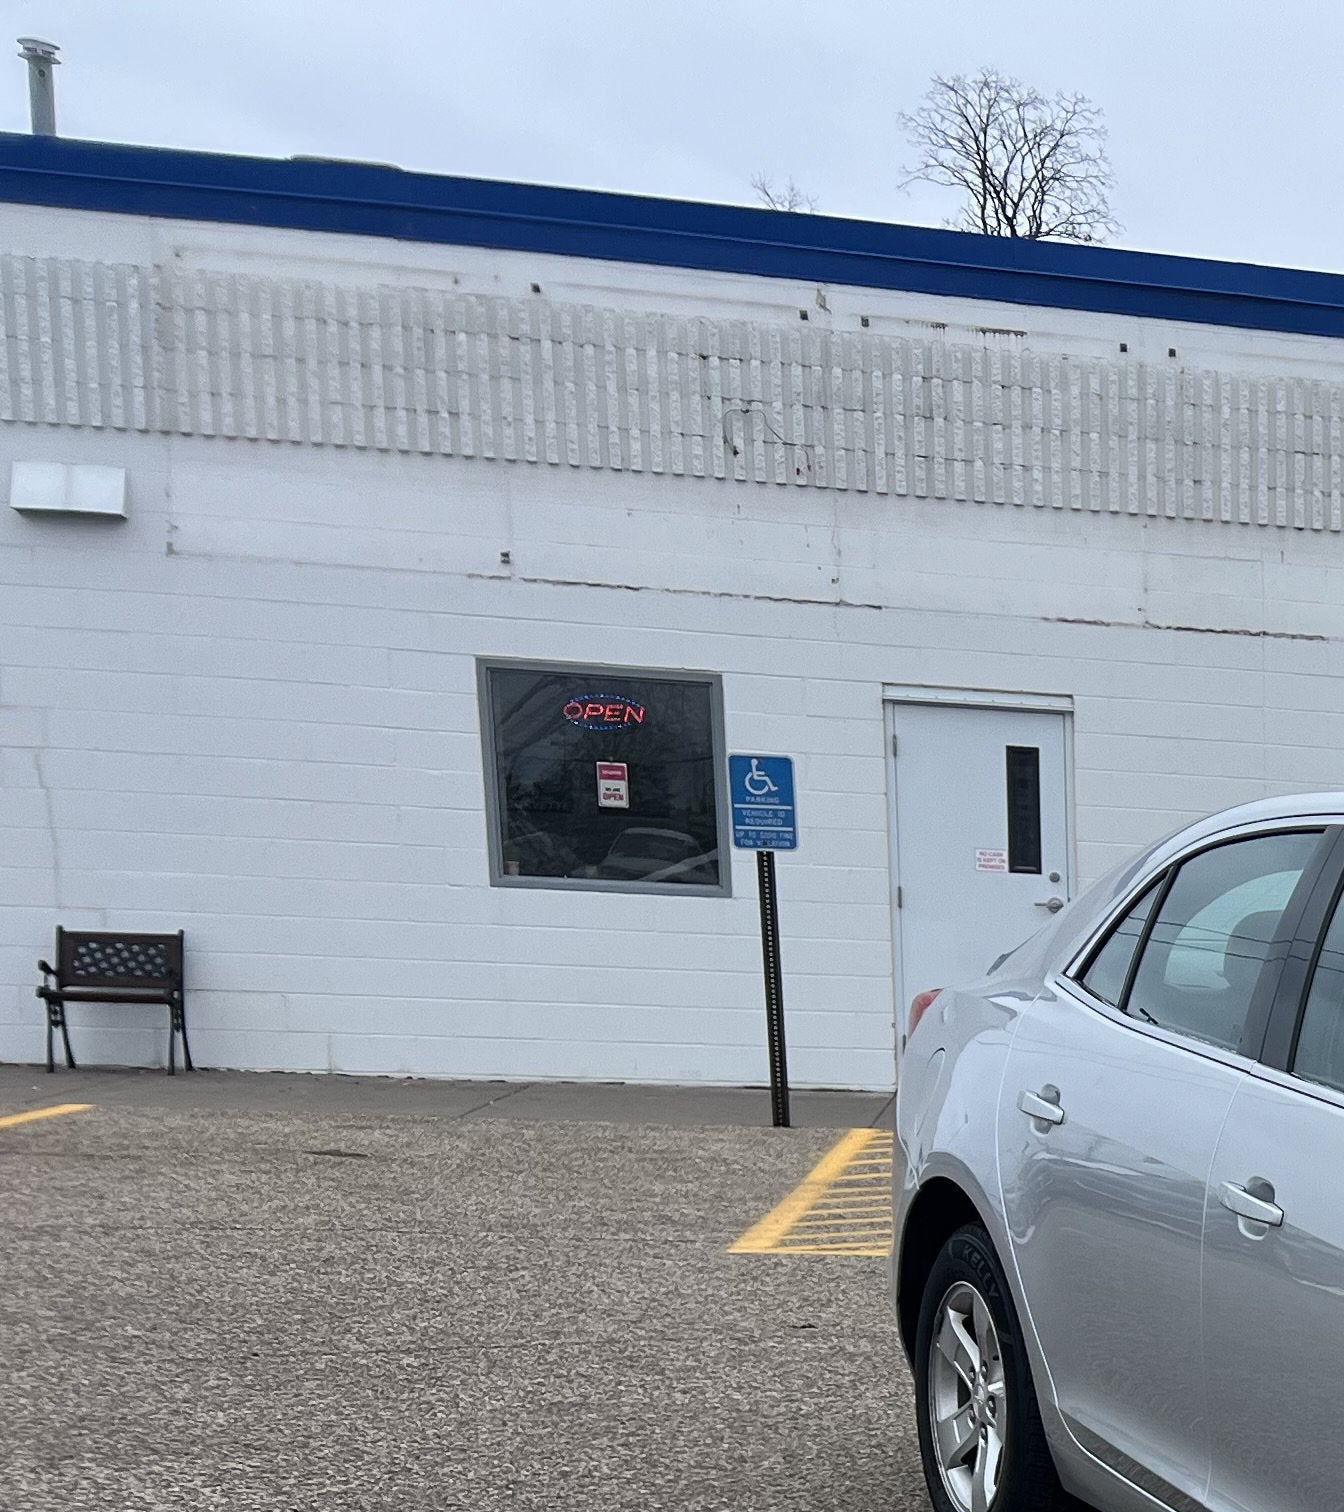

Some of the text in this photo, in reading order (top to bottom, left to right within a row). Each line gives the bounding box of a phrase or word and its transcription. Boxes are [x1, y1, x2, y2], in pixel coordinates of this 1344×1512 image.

[563, 702, 646, 724] OPEN
[603, 792, 624, 801] OPEN
[742, 809, 773, 818] VEHICLE
[744, 817, 783, 826] REQUIRED
[756, 839, 790, 847] VLATION
[962, 1244, 999, 1297] KELLY
